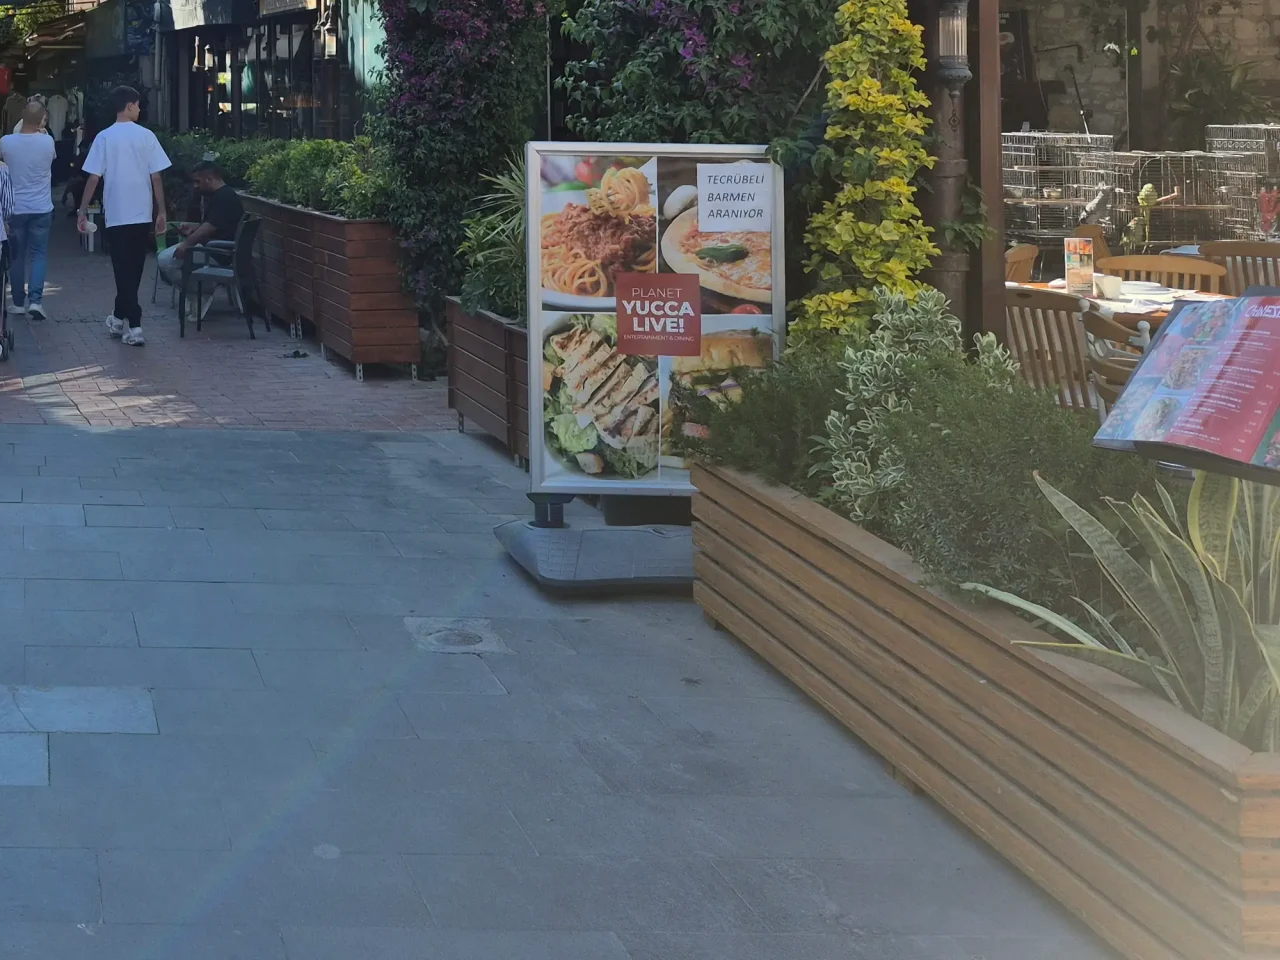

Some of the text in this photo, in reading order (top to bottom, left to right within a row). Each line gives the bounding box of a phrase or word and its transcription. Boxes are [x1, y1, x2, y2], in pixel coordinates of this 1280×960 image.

[707, 192, 756, 202] BARMEN
[707, 209, 764, 218] ARANIYOR
[632, 288, 682, 298] PLANET
[621, 300, 695, 316] YUCCA
[632, 317, 685, 333] LIVE!
